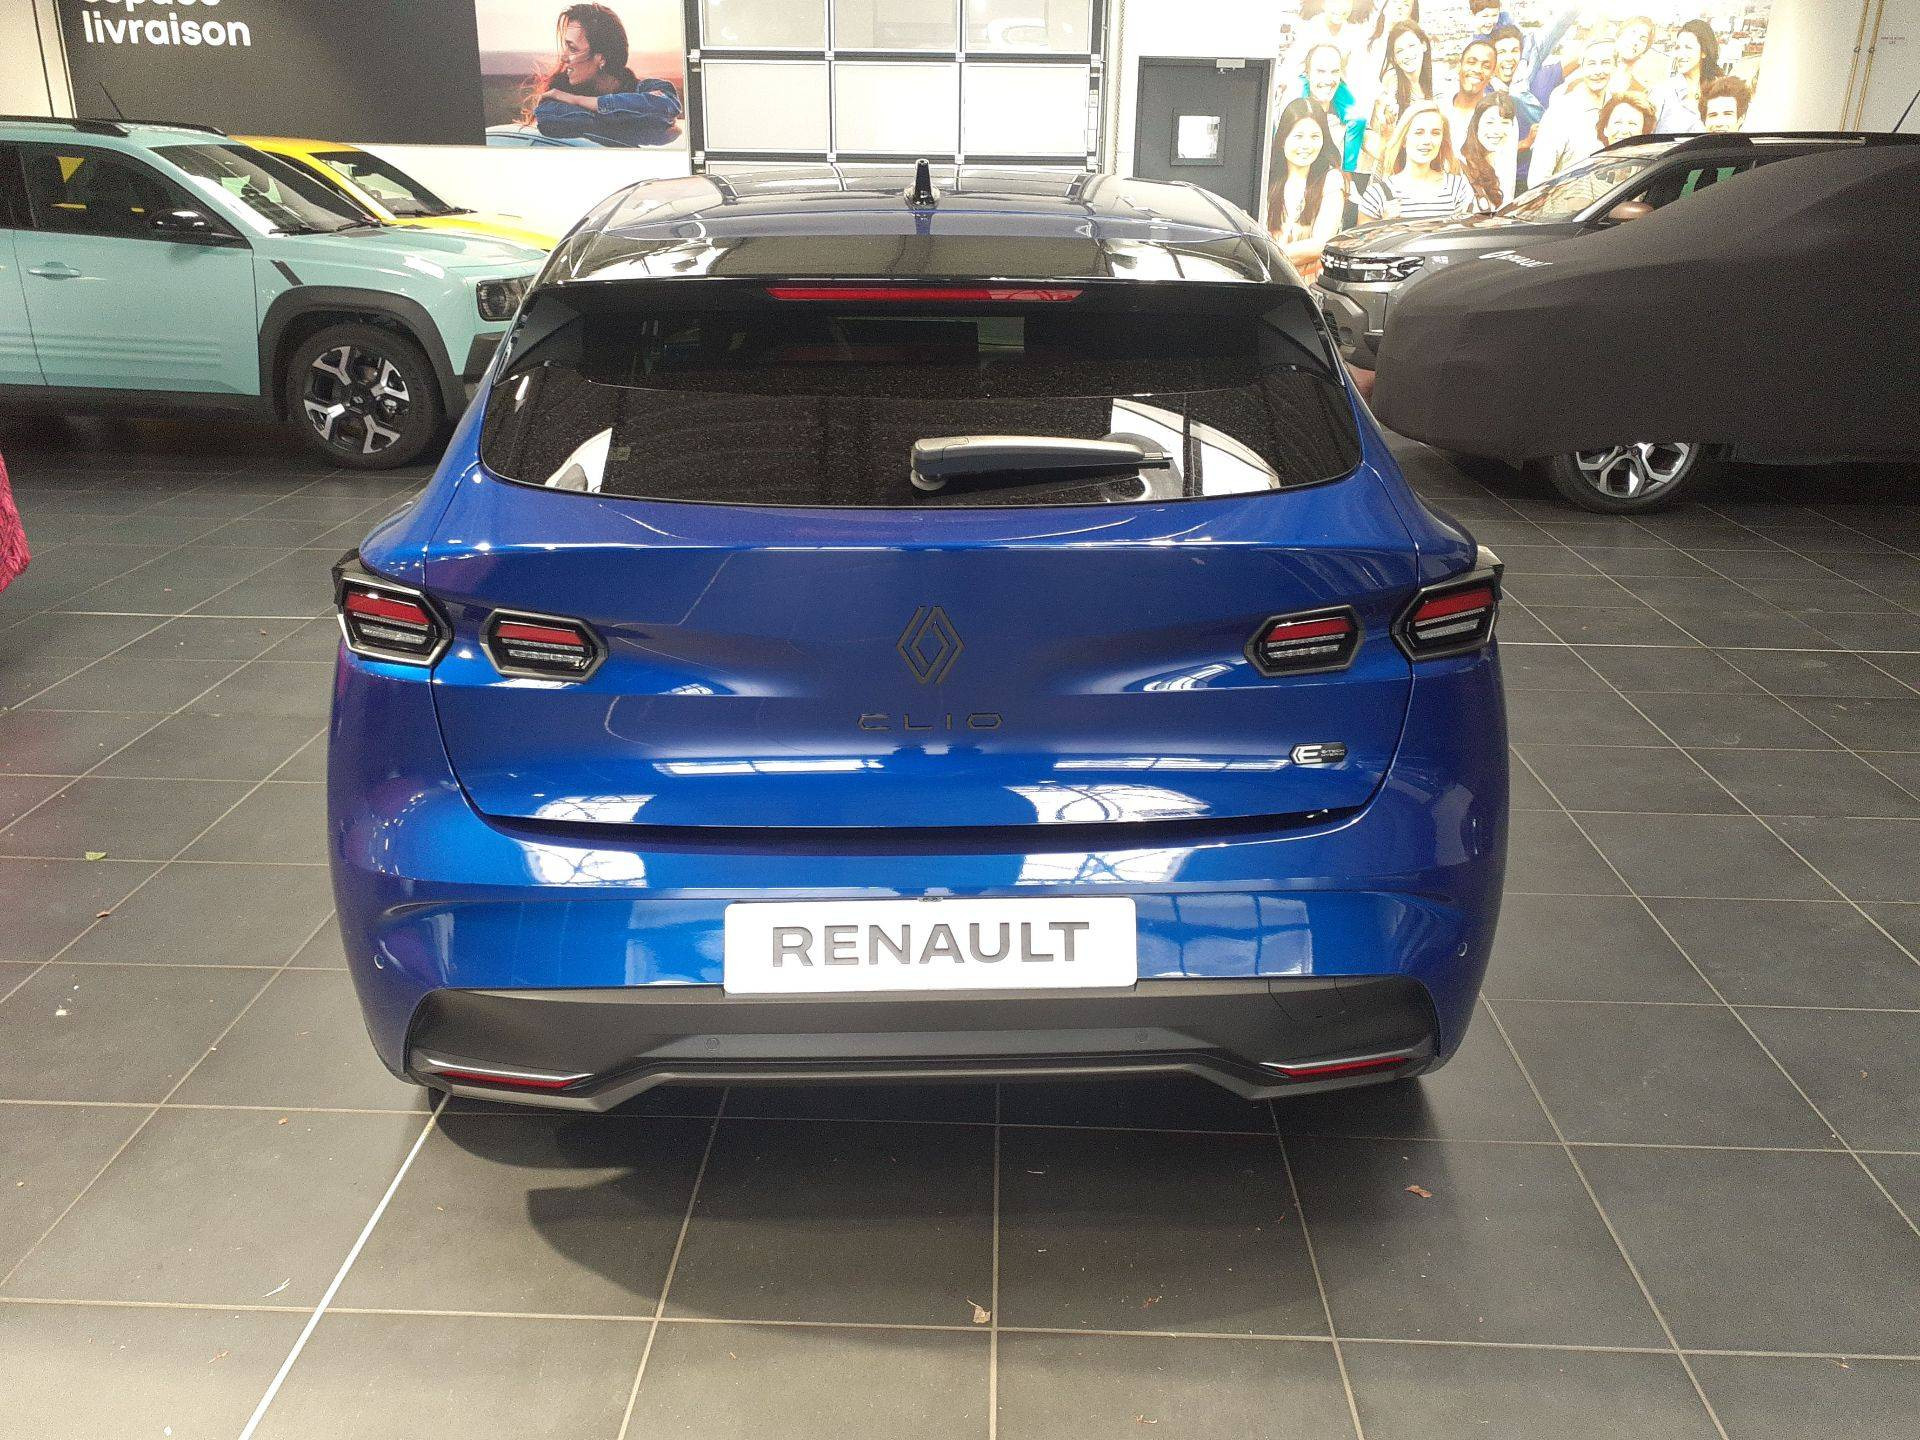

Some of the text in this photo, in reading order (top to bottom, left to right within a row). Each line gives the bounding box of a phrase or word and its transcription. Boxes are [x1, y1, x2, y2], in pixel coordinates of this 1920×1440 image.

[82, 10, 251, 46] livraison
[857, 712, 1003, 732] CLIO
[772, 921, 1090, 967] RENAULT
